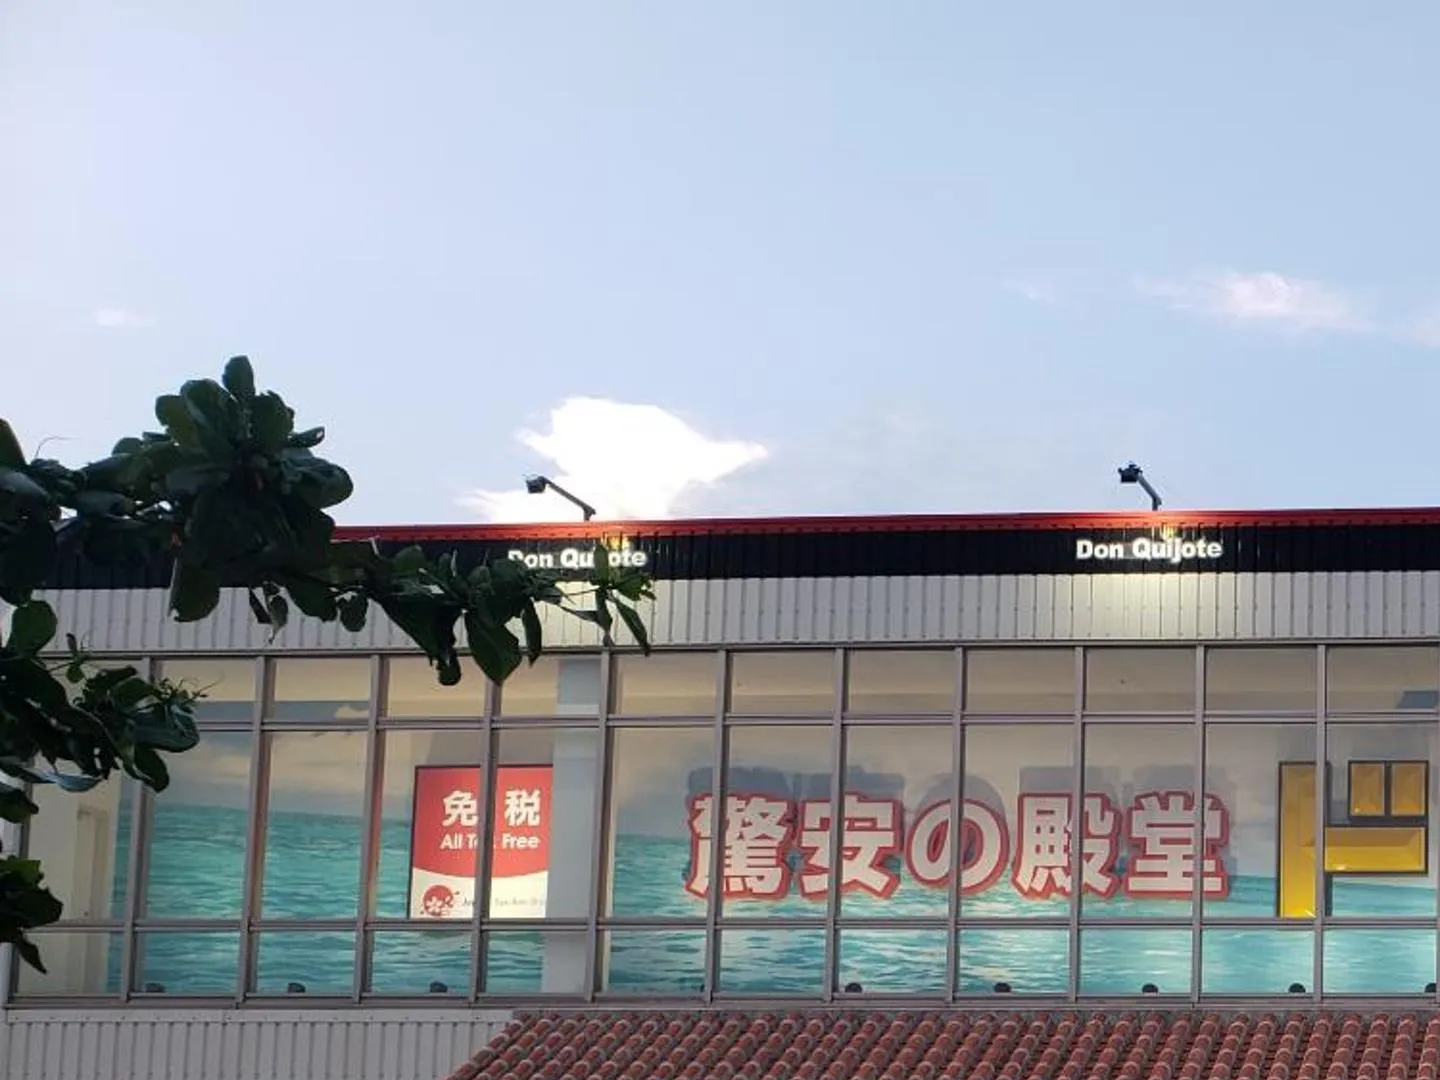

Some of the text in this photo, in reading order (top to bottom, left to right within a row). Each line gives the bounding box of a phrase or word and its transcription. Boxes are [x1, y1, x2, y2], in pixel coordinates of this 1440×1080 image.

[560, 548, 648, 569] Quote
[1076, 537, 1223, 563] Don Quijote
[441, 834, 462, 848] All
[502, 834, 541, 848] Free
[686, 793, 1231, 899] 驚安の殿堂
